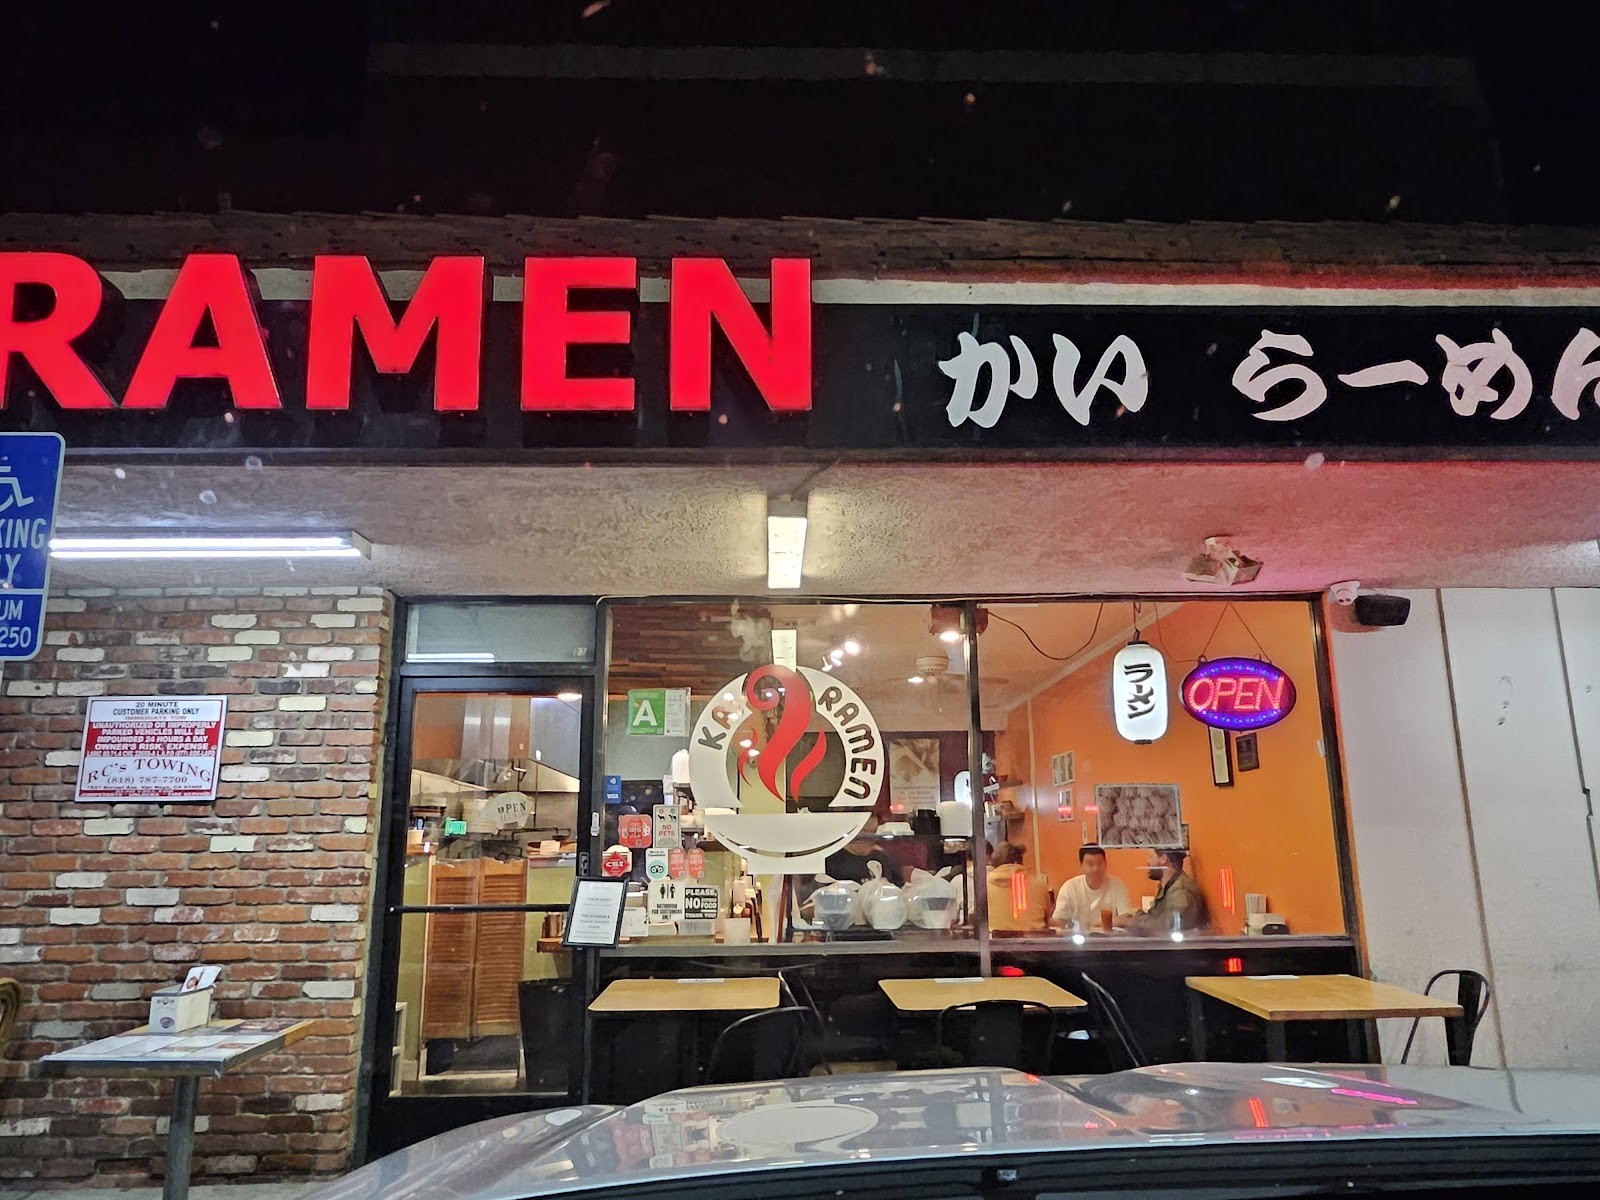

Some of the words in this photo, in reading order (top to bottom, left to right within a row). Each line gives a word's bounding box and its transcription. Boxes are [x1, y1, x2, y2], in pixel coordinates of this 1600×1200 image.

[0, 252, 812, 411] RAMEN
[937, 331, 1149, 428] かい
[1124, 663, 1156, 719] ラーメン
[1188, 677, 1285, 711] OPEN
[112, 708, 149, 716] CUSTOMER
[182, 707, 200, 715] ONLY
[632, 699, 658, 726] A
[92, 721, 153, 729] UNAUTHORIZED
[154, 721, 167, 729] OR
[97, 735, 144, 743] IMPOUNDED
[145, 735, 156, 743] 24
[156, 735, 184, 743] HOURS
[818, 686, 877, 799] RAMEN
[107, 776, 135, 784] (818)
[139, 776, 188, 784] 787-7700
[134, 758, 211, 783] TOWING
[685, 897, 701, 909] NO
